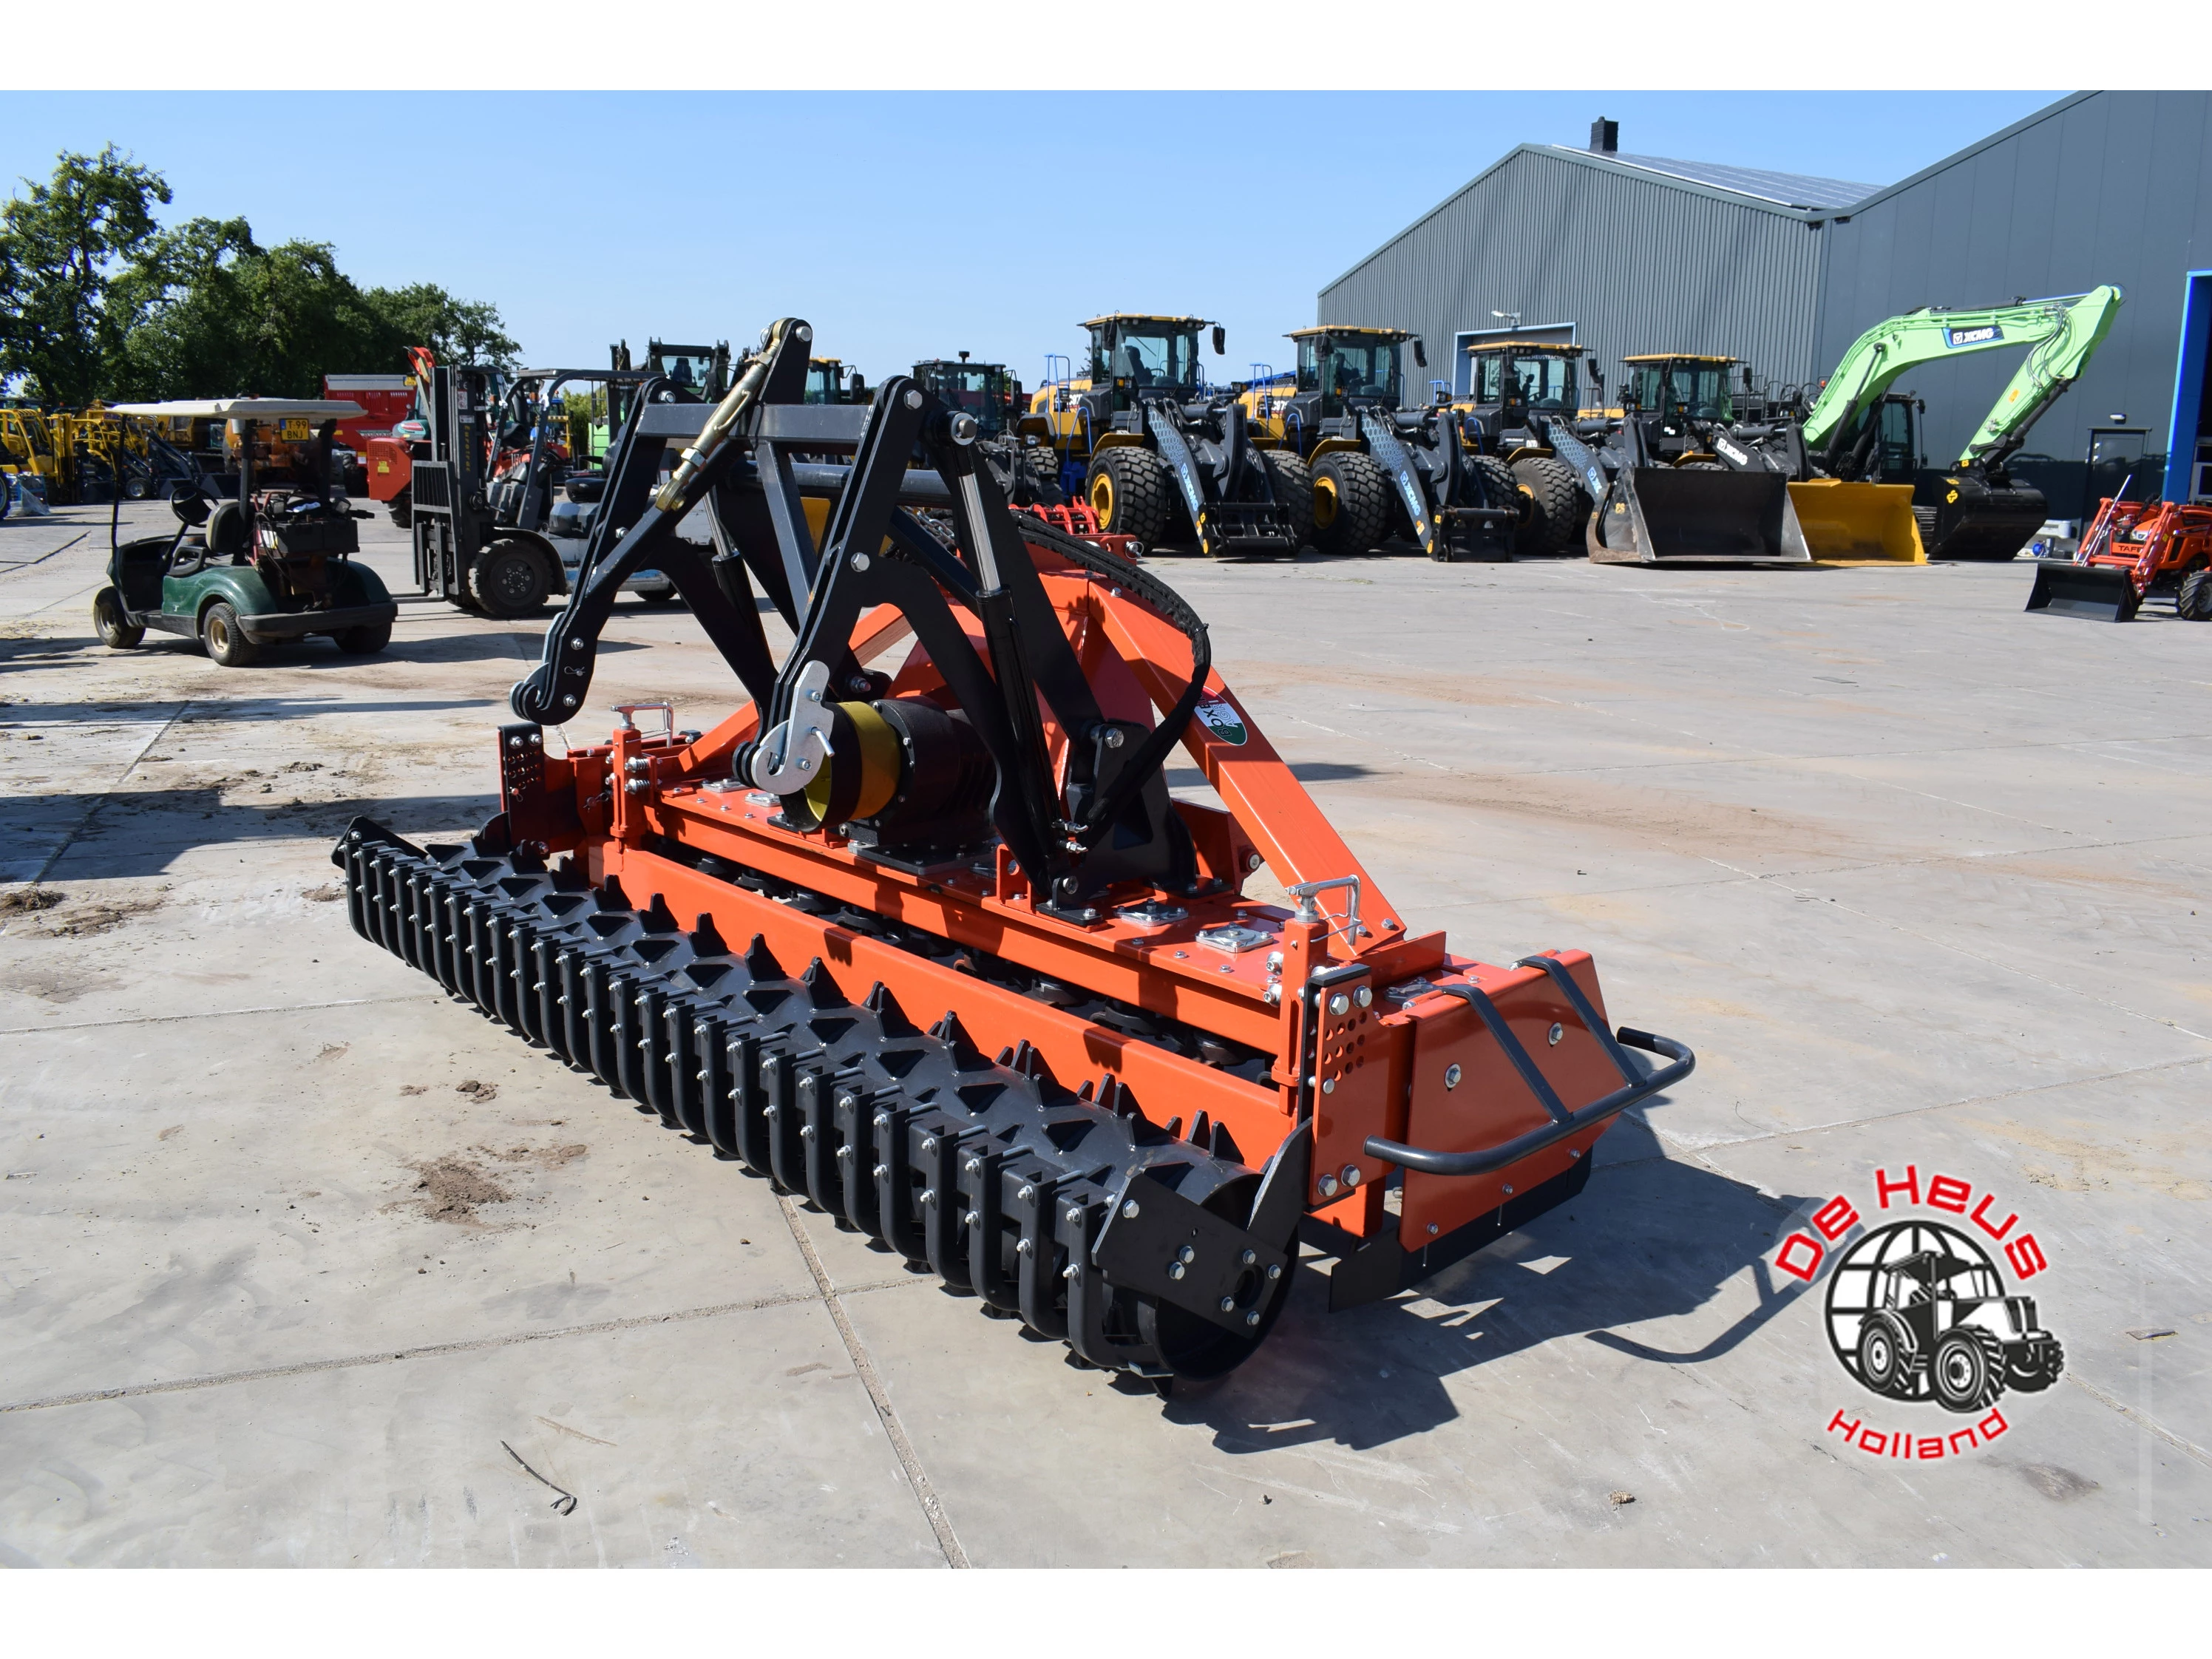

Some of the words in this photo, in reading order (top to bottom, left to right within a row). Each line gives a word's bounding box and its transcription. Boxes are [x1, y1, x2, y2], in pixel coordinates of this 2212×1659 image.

[1963, 328, 1995, 343] XCMG
[288, 421, 307, 430] T-99
[287, 430, 303, 439] BNJ
[1404, 481, 1421, 516] XCMG
[1208, 699, 1238, 728] AGRI
